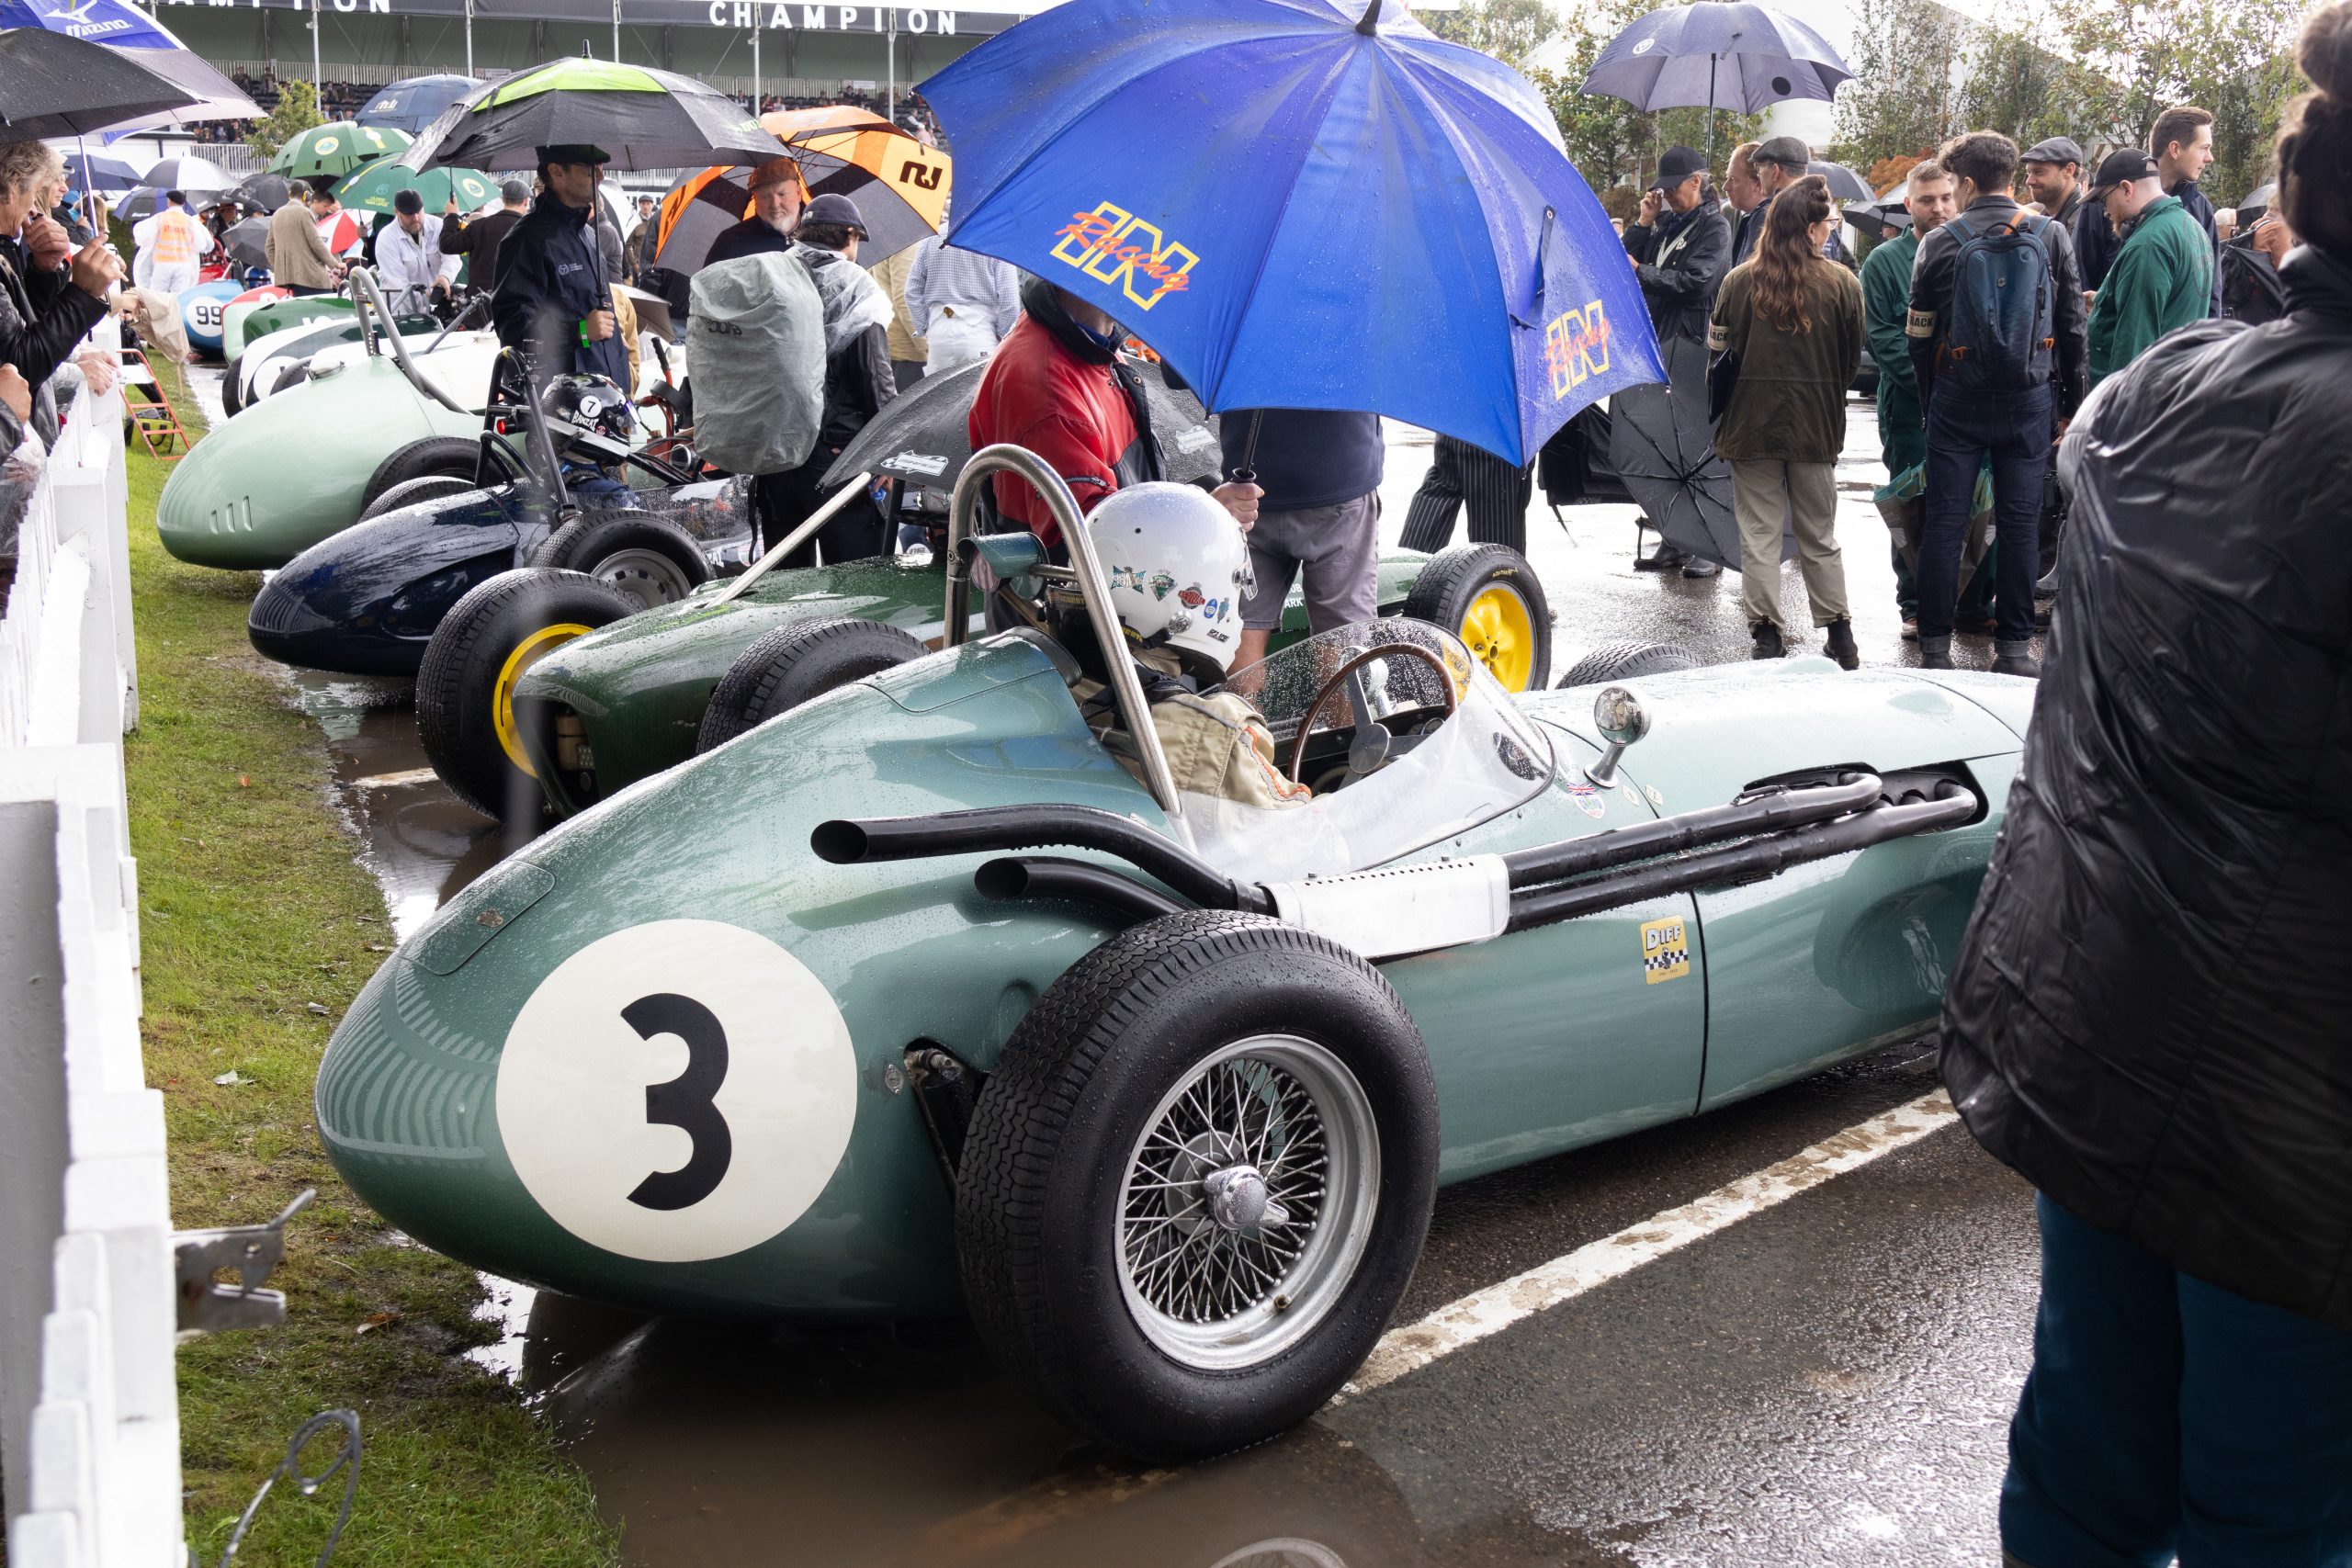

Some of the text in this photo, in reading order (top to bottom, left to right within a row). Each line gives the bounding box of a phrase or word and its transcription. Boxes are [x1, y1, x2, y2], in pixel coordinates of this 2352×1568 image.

[709, 1, 956, 34] CHAMPION
[1054, 211, 1190, 294] Racing
[196, 305, 222, 326] 99
[1908, 315, 1933, 328] RACK
[588, 400, 596, 413] 7
[1179, 591, 1205, 604] REVIVAL
[1645, 924, 1681, 952] DIFF
[619, 992, 733, 1212] 3
